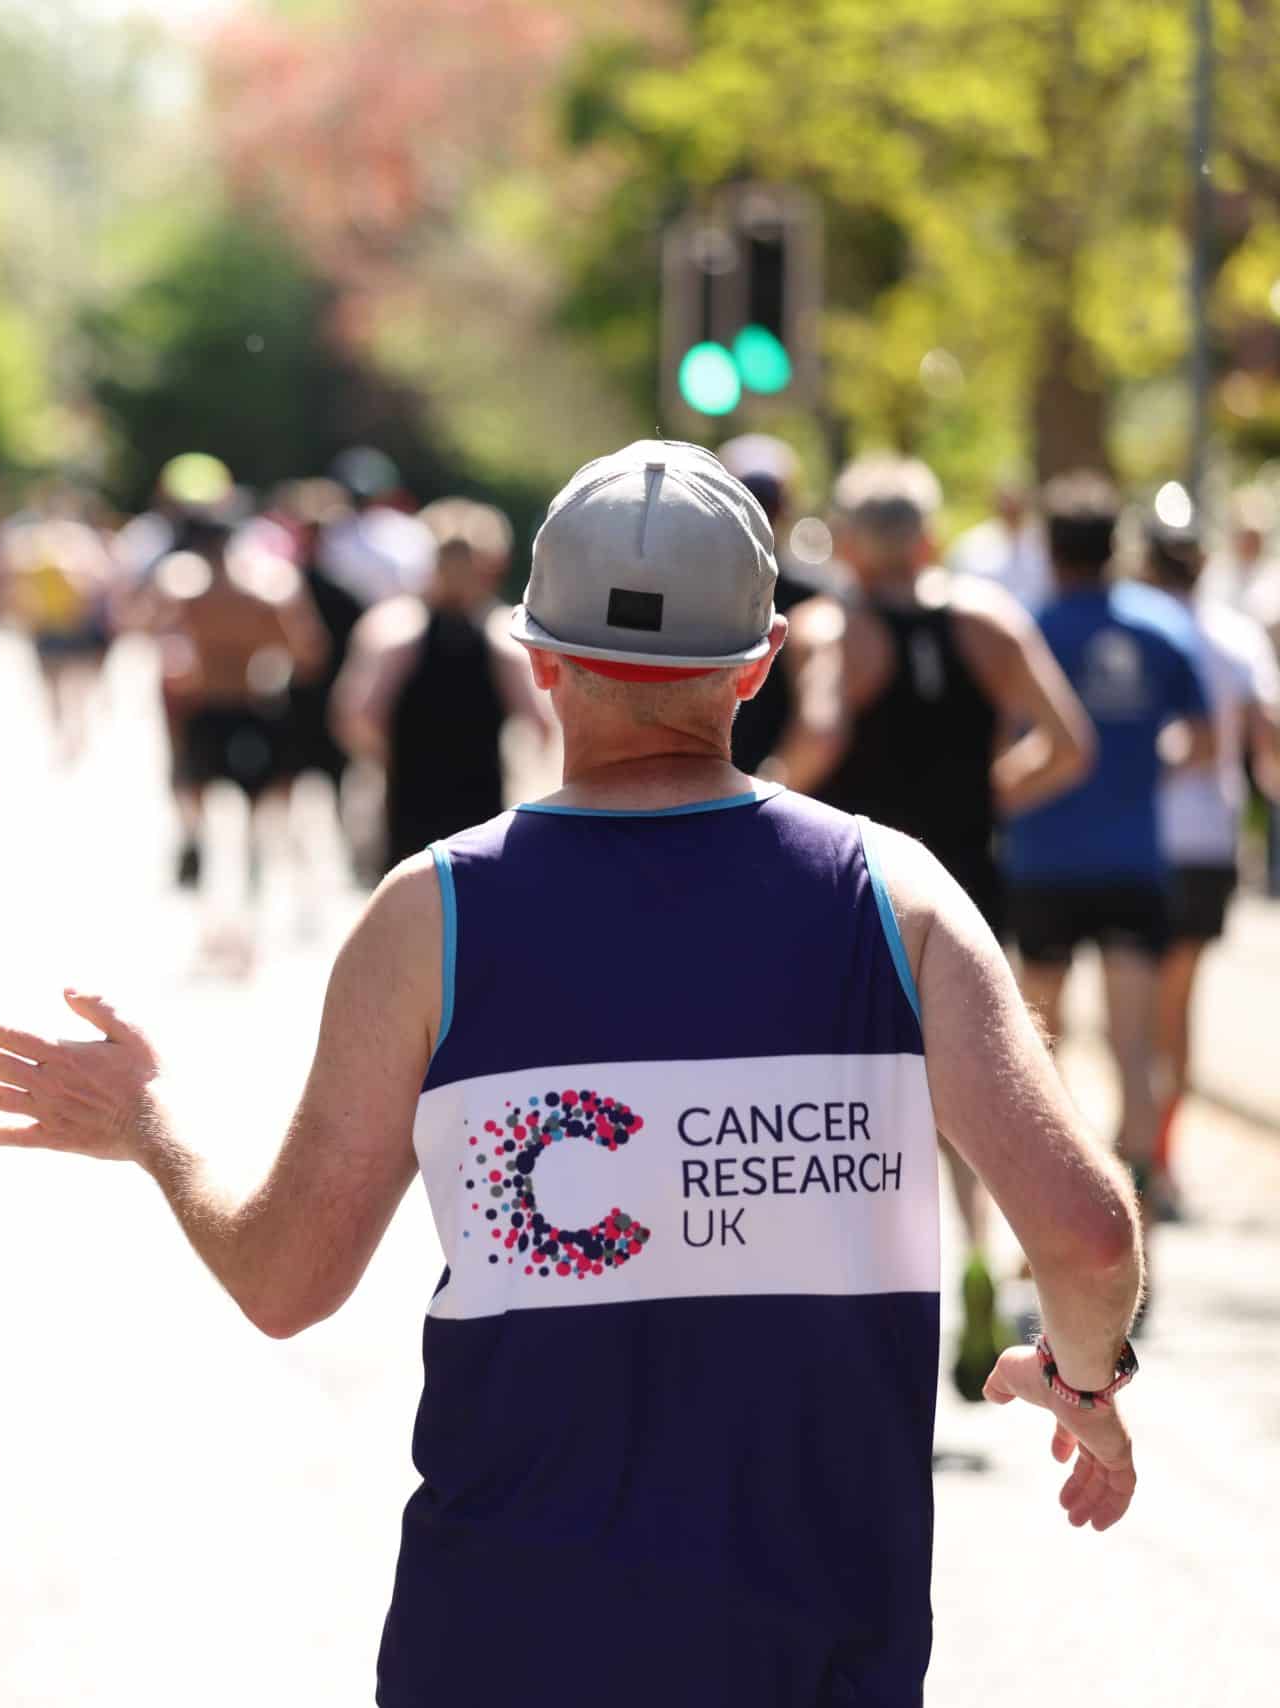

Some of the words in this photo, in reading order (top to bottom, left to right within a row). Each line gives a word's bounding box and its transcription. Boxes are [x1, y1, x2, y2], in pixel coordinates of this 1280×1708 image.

[677, 1101, 871, 1147] CANCER
[681, 1151, 903, 1198] RESEARCH
[682, 1207, 747, 1247] UK
